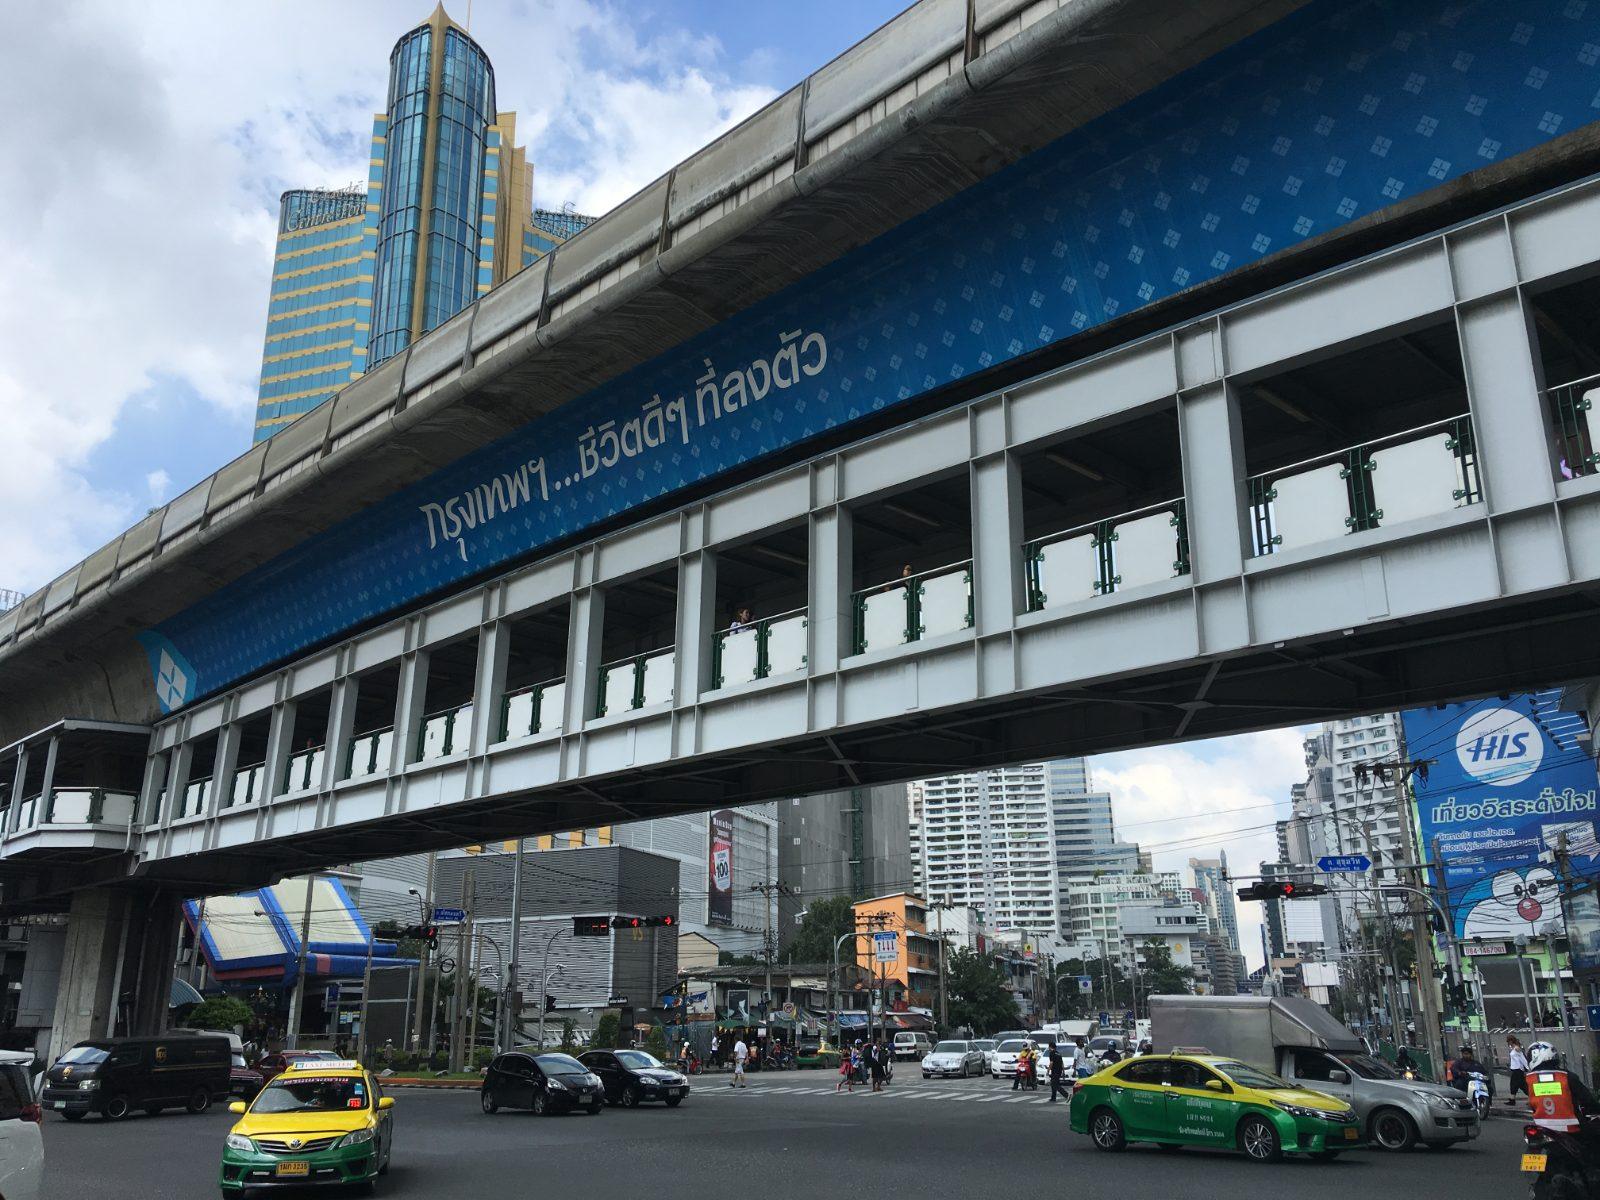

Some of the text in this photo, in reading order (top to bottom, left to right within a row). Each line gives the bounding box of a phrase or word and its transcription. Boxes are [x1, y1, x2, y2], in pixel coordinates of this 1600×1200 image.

[696, 329, 828, 427] ที่ลงตัว
[1432, 787, 1596, 823] เที่ยวอิสระดั่งใจ!
[716, 861, 728, 879] 100
[1542, 1097, 1555, 1115] 9
